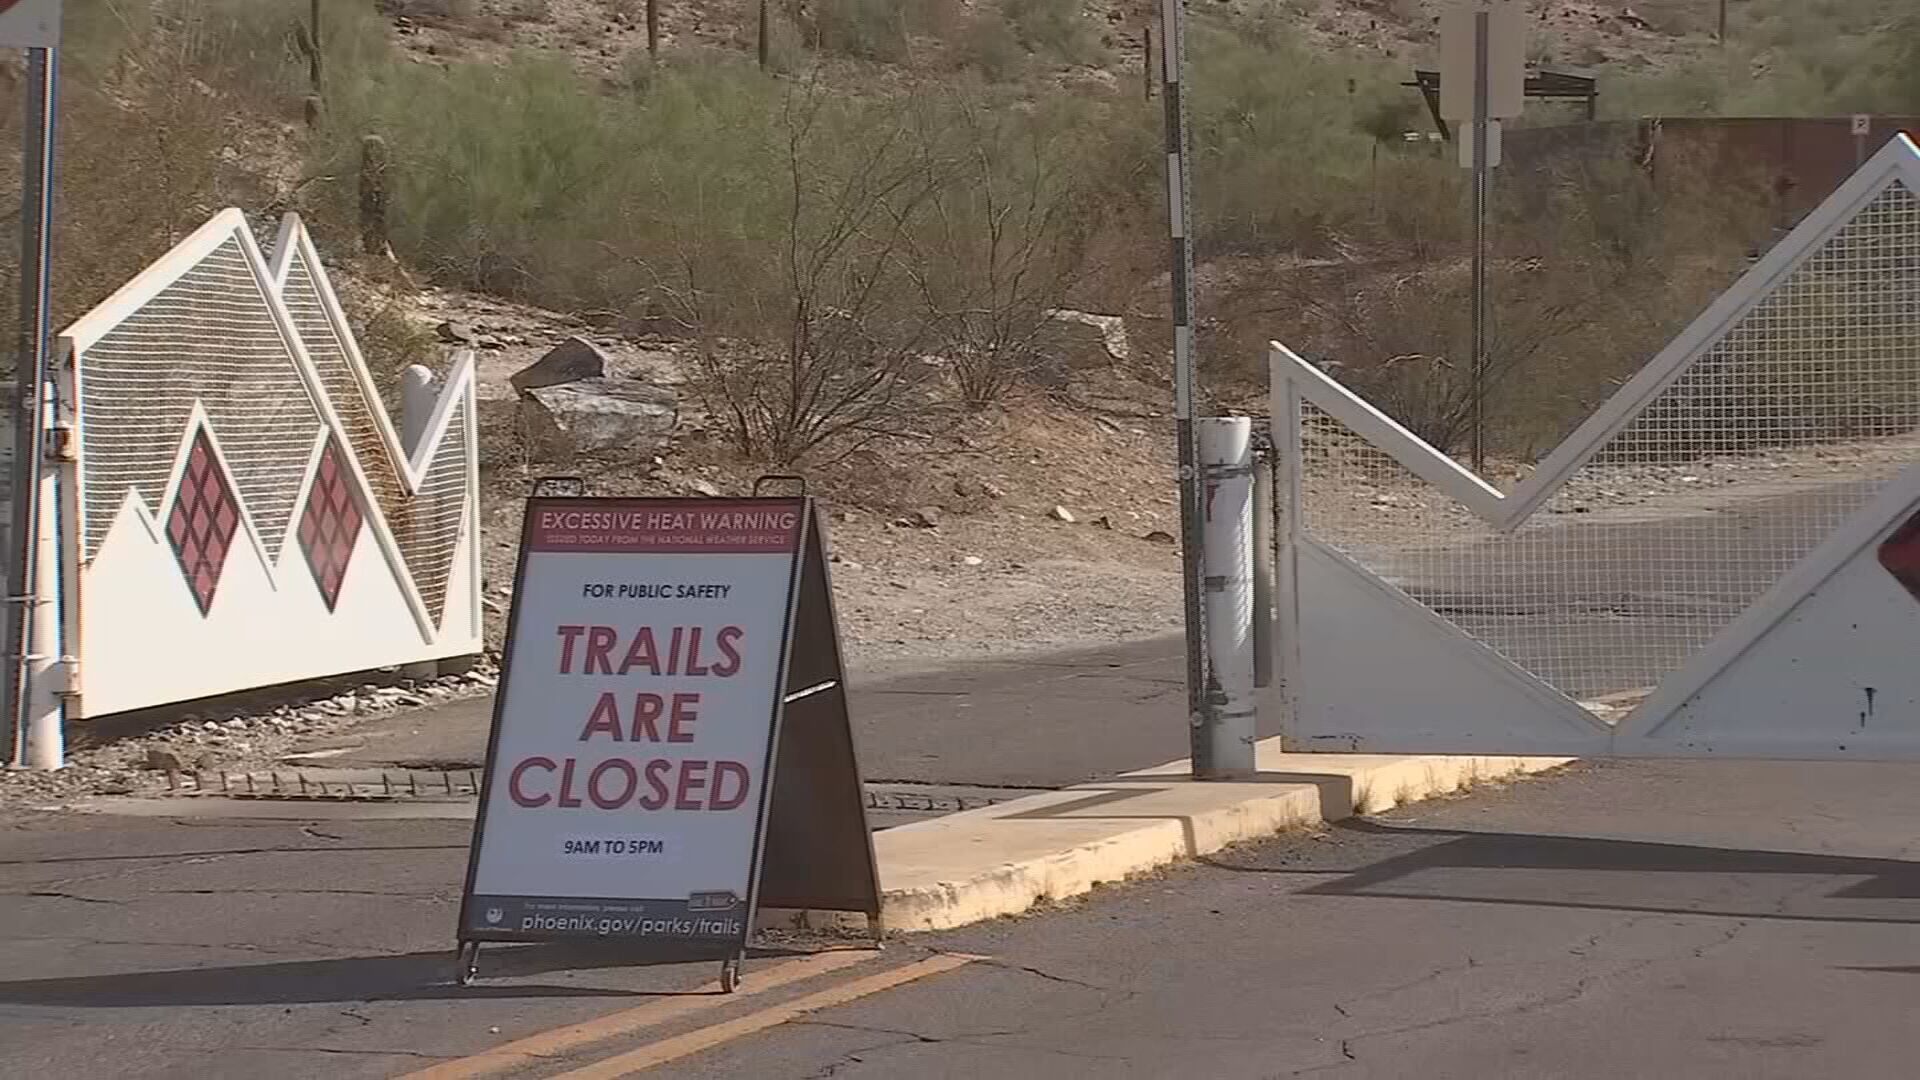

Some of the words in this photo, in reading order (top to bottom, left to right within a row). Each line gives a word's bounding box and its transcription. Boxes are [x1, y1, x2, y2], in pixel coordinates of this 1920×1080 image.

[542, 512, 641, 529] EXCESSIVE
[647, 513, 694, 529] HEAT
[700, 513, 796, 530] WARNING
[579, 536, 611, 544] TODAY
[612, 536, 639, 544] FROM
[657, 536, 704, 544] NATIONAL
[583, 584, 614, 597] FOR
[618, 585, 673, 598] PUBLIC
[676, 585, 730, 598] SAFETY
[557, 625, 744, 677] TRAILS
[579, 692, 700, 742] ARE
[509, 757, 750, 811] CLOSED
[564, 841, 600, 854] 9AM
[605, 841, 624, 854] TO
[628, 841, 663, 854] 5PM
[521, 914, 740, 936] phoenix.gov/parks/trails
